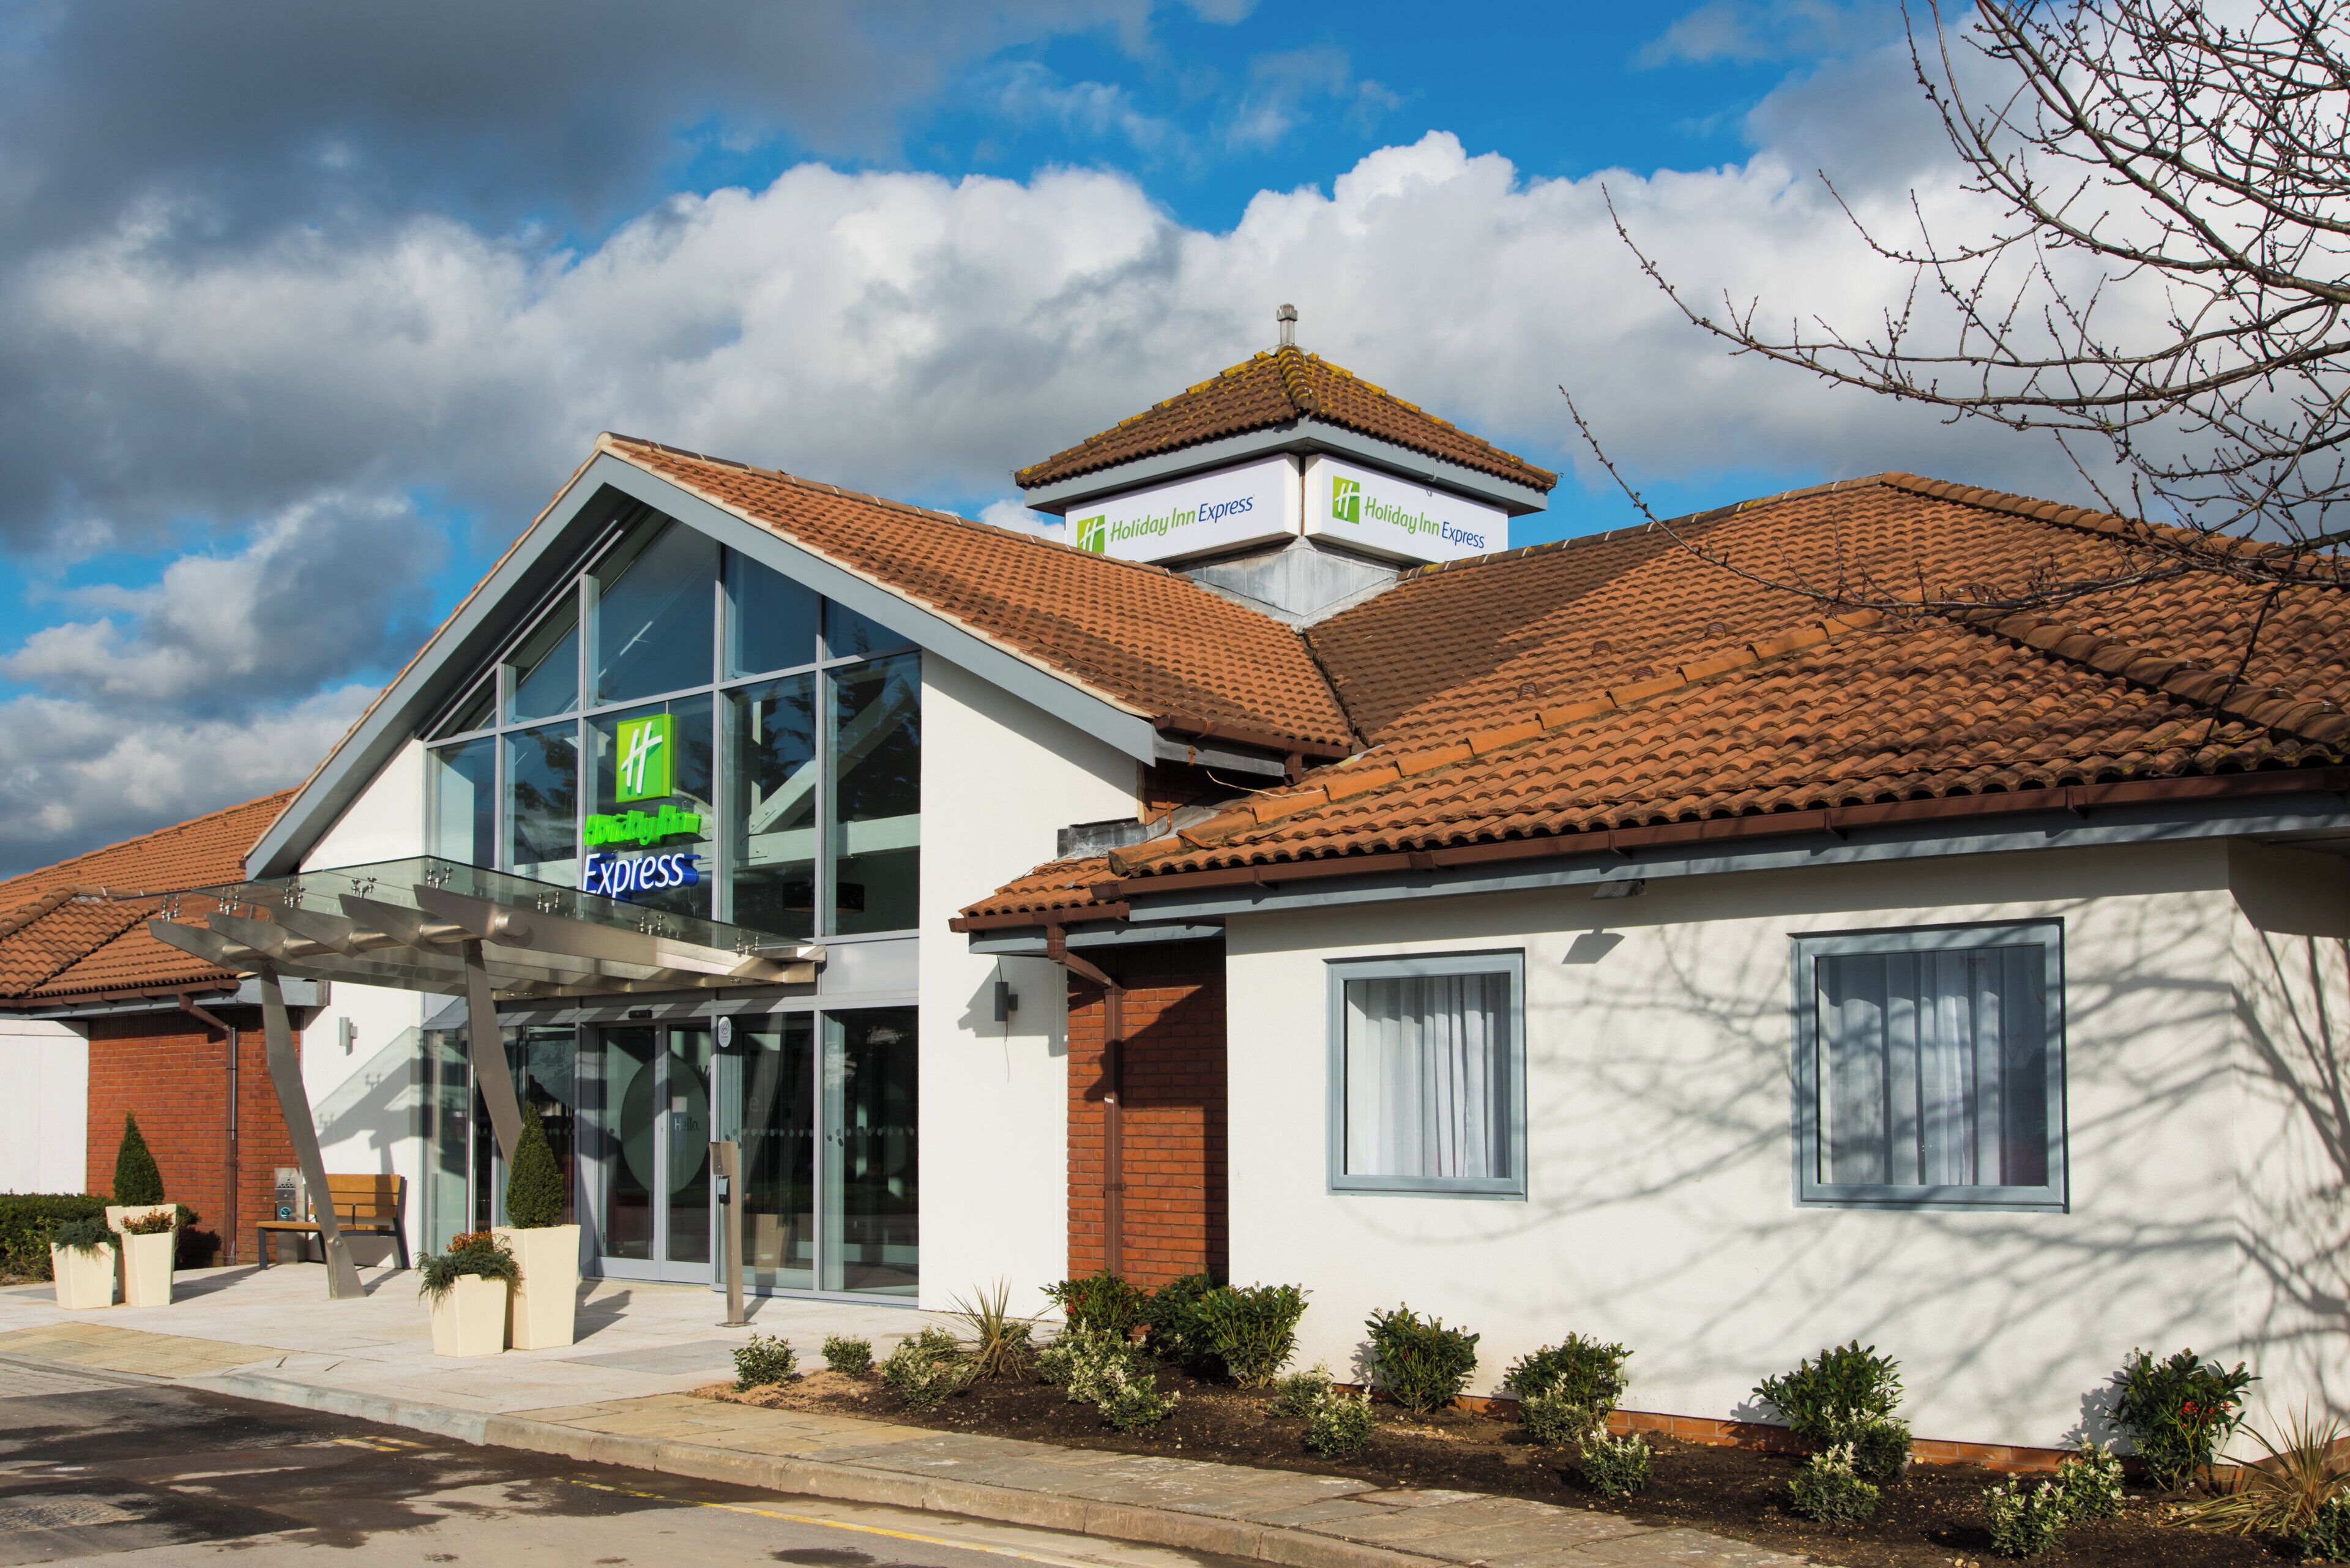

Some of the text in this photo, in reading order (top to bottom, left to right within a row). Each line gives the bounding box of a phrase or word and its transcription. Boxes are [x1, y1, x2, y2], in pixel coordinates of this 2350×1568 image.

[1110, 514, 1169, 542] Holiday
[1171, 507, 1195, 528] Inn
[1198, 496, 1253, 523] Express
[1365, 496, 1417, 535] Holiday
[1419, 512, 1439, 536] Inn
[1441, 521, 1485, 549] Express
[583, 805, 693, 846] Holiday Inn
[582, 853, 688, 899] Express
[674, 1117, 700, 1132] Hello.
